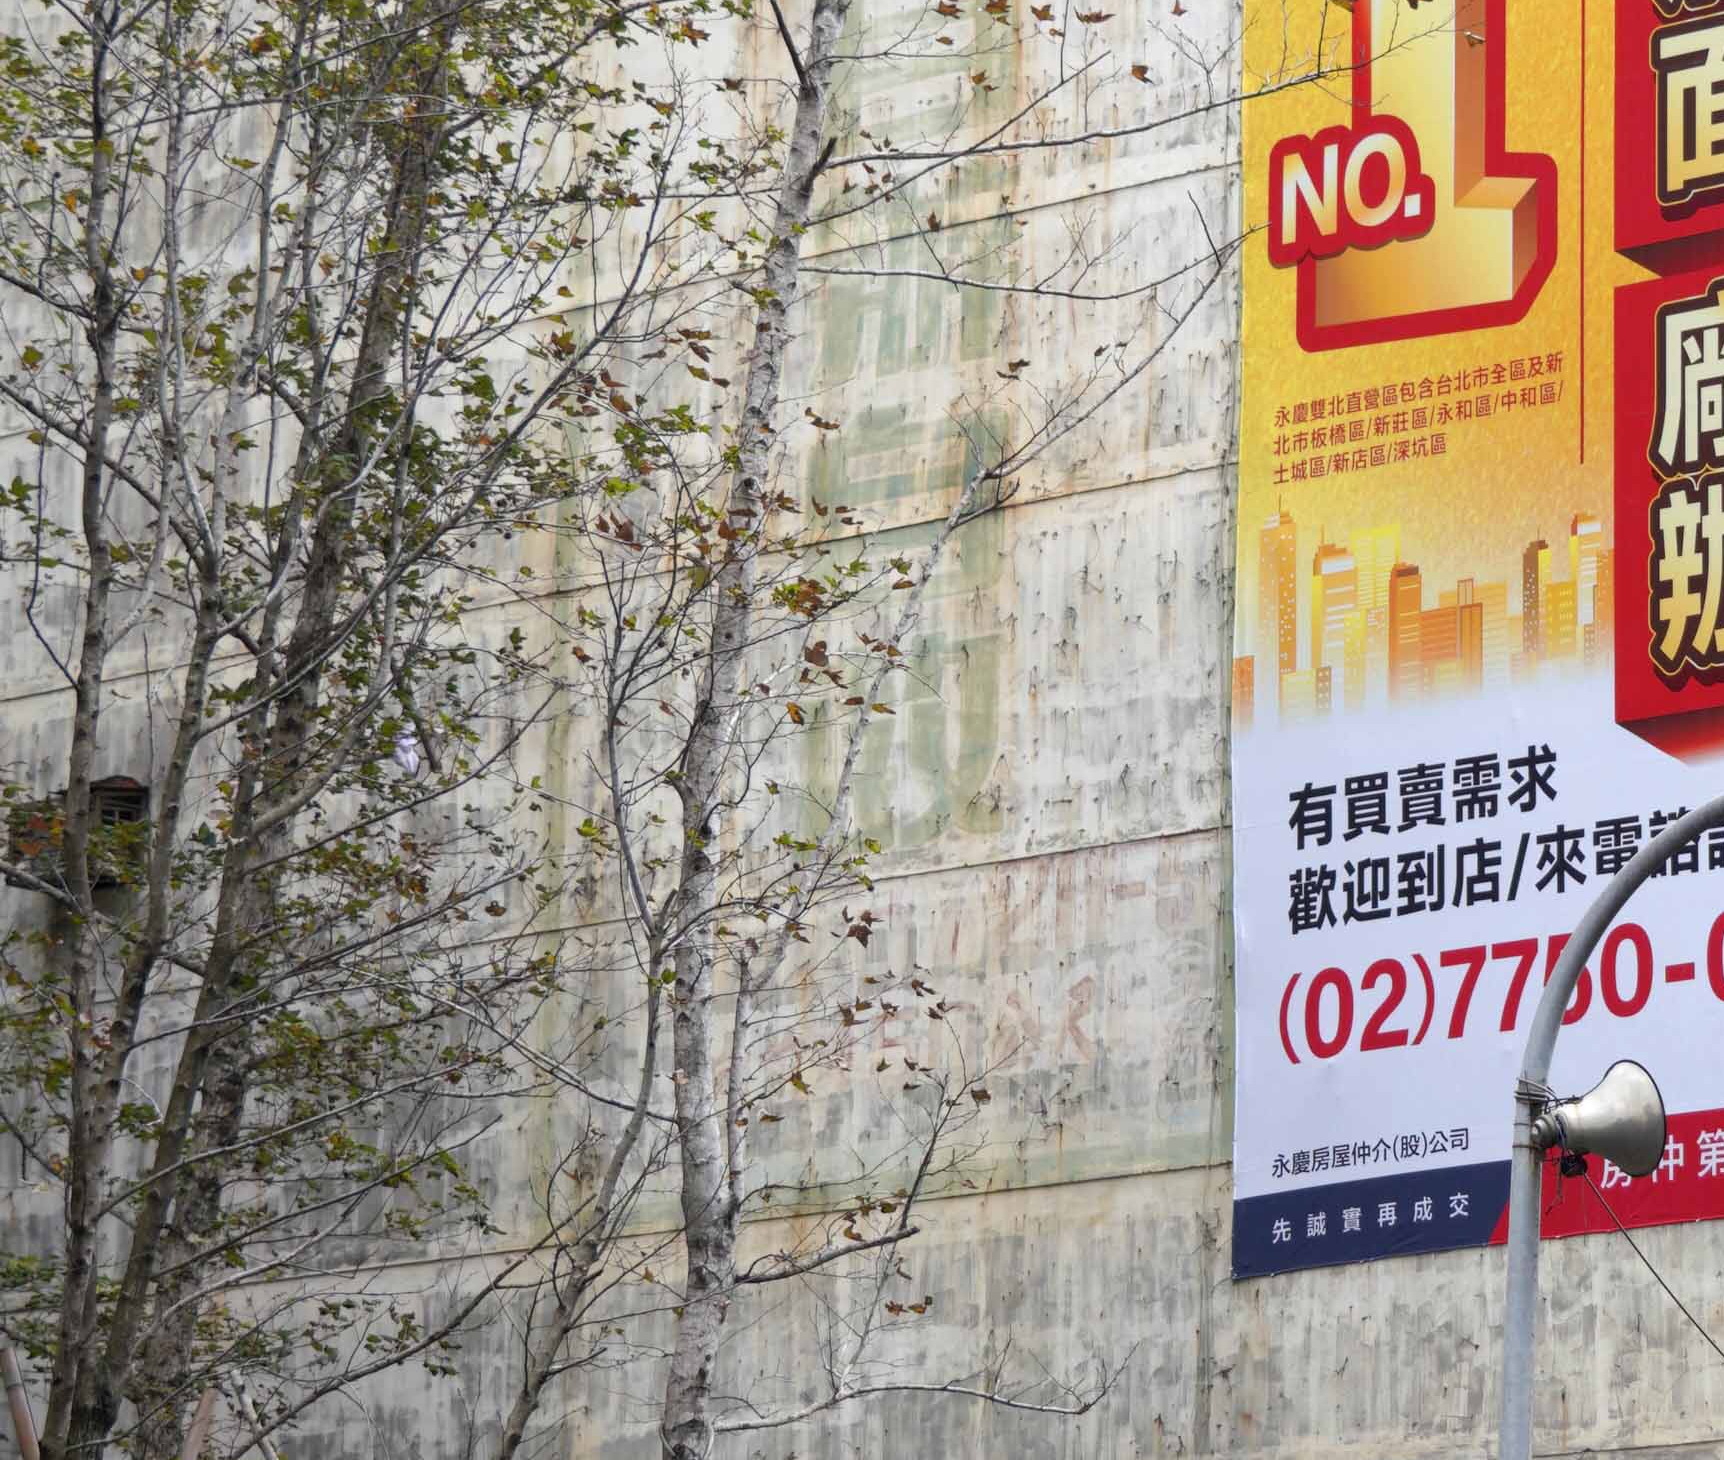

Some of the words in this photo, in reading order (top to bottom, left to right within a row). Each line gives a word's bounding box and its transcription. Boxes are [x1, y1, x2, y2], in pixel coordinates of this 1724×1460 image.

[1279, 130, 1424, 248] NO.
[1273, 350, 1564, 429] 永慶雙北直營區包含台北市全區及新
[1273, 380, 1565, 457] 北市板橋區/新莊區/永和區/中和區/
[1272, 432, 1448, 485] 土城區/新店區/深坑區
[1288, 743, 1558, 850] 有買賣需求
[1271, 1127, 1470, 1179] 永慶房屋仲介(股)公司
[1271, 1191, 1470, 1245] 先誠實再成交
